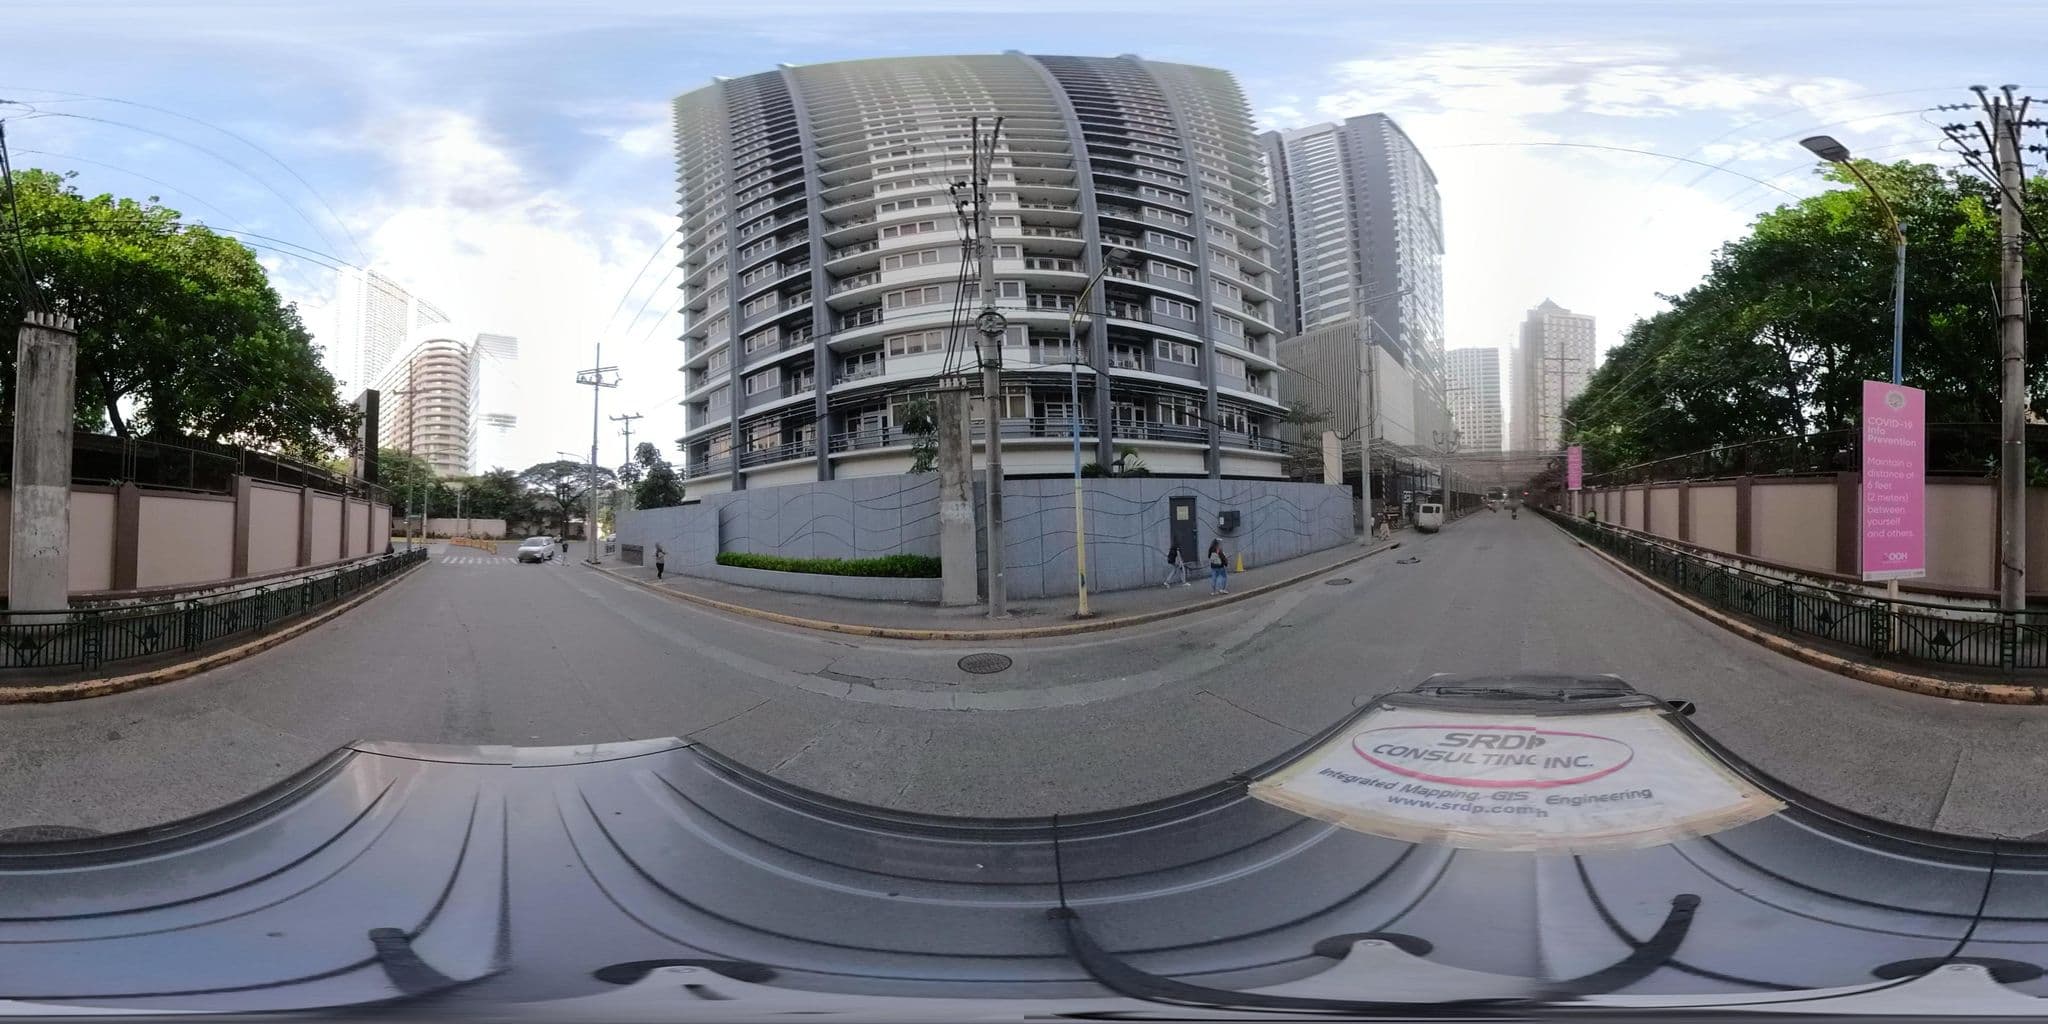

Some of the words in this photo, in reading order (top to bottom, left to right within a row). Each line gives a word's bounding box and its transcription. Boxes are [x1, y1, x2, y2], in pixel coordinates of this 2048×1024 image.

[1868, 416, 1913, 429] COVID-19
[1868, 426, 1886, 435] Info
[1868, 434, 1917, 447] Prevention
[1867, 456, 1905, 468] Maintain
[1867, 470, 1904, 479] distance
[1906, 470, 1914, 480] of
[1867, 480, 1873, 489] 6
[1874, 480, 1892, 490] feet
[1867, 492, 1876, 502] (2
[1877, 492, 1909, 503] meters)
[1867, 504, 1905, 514] between
[1867, 517, 1901, 528] yourself
[1867, 529, 1885, 537] and
[1437, 732, 1546, 749] SRDP
[1543, 755, 1595, 769] INC.
[1318, 767, 1399, 790] Integrated
[1491, 790, 1530, 801] GIS
[1545, 788, 1653, 807] Engineering
